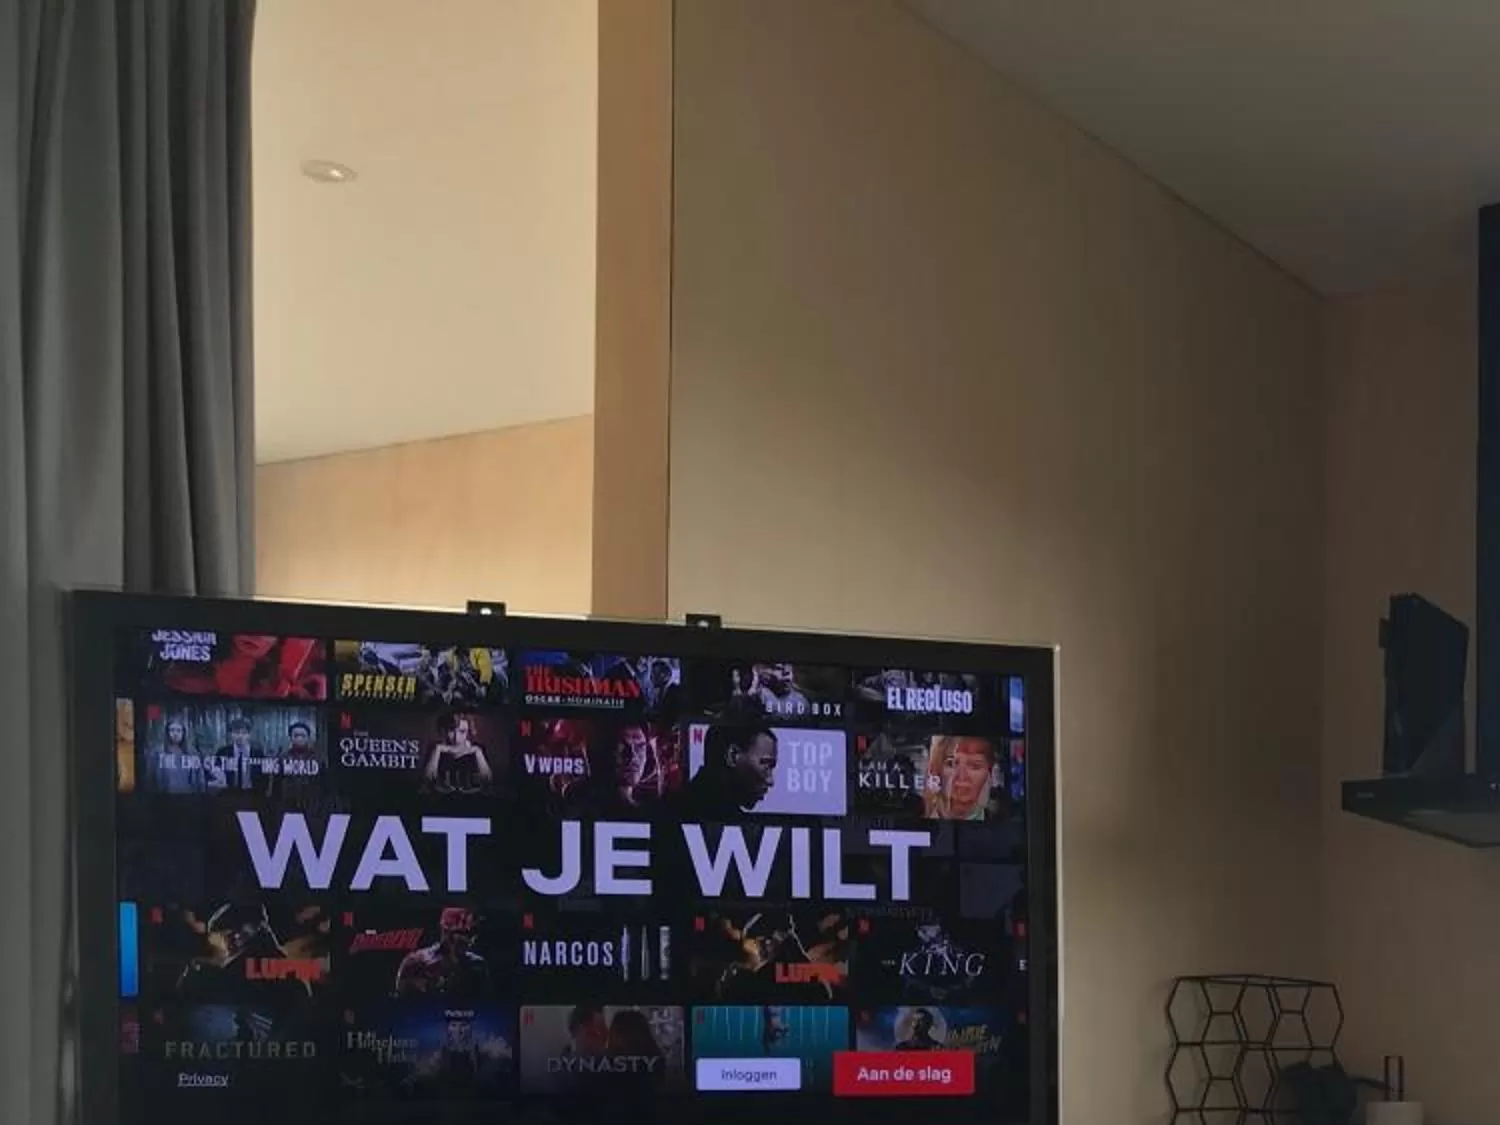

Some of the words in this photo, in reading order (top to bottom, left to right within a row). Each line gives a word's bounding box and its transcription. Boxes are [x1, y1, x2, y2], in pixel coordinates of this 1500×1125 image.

[160, 644, 211, 662] JONES
[341, 673, 417, 693] SPENSER
[887, 686, 904, 710] EL
[905, 684, 974, 714] RECLUSO
[765, 702, 805, 715] BIRD
[811, 703, 842, 716] BOX
[341, 753, 419, 769] GAMBIT
[788, 741, 833, 767] TOP
[282, 757, 320, 776] WORLD
[788, 767, 833, 793] BOY
[859, 773, 942, 791] KILLER
[237, 811, 491, 893] WAT
[521, 820, 653, 896] JE
[681, 823, 931, 901] WILT
[523, 940, 614, 966] NARCOS
[899, 952, 986, 977] KING
[164, 1040, 316, 1060] FRACTURED
[547, 1055, 659, 1073] DYNASTY
[178, 1071, 230, 1087] Privacy
[857, 1066, 890, 1082] Aan
[893, 1065, 915, 1081] de
[917, 1065, 952, 1084] slag
